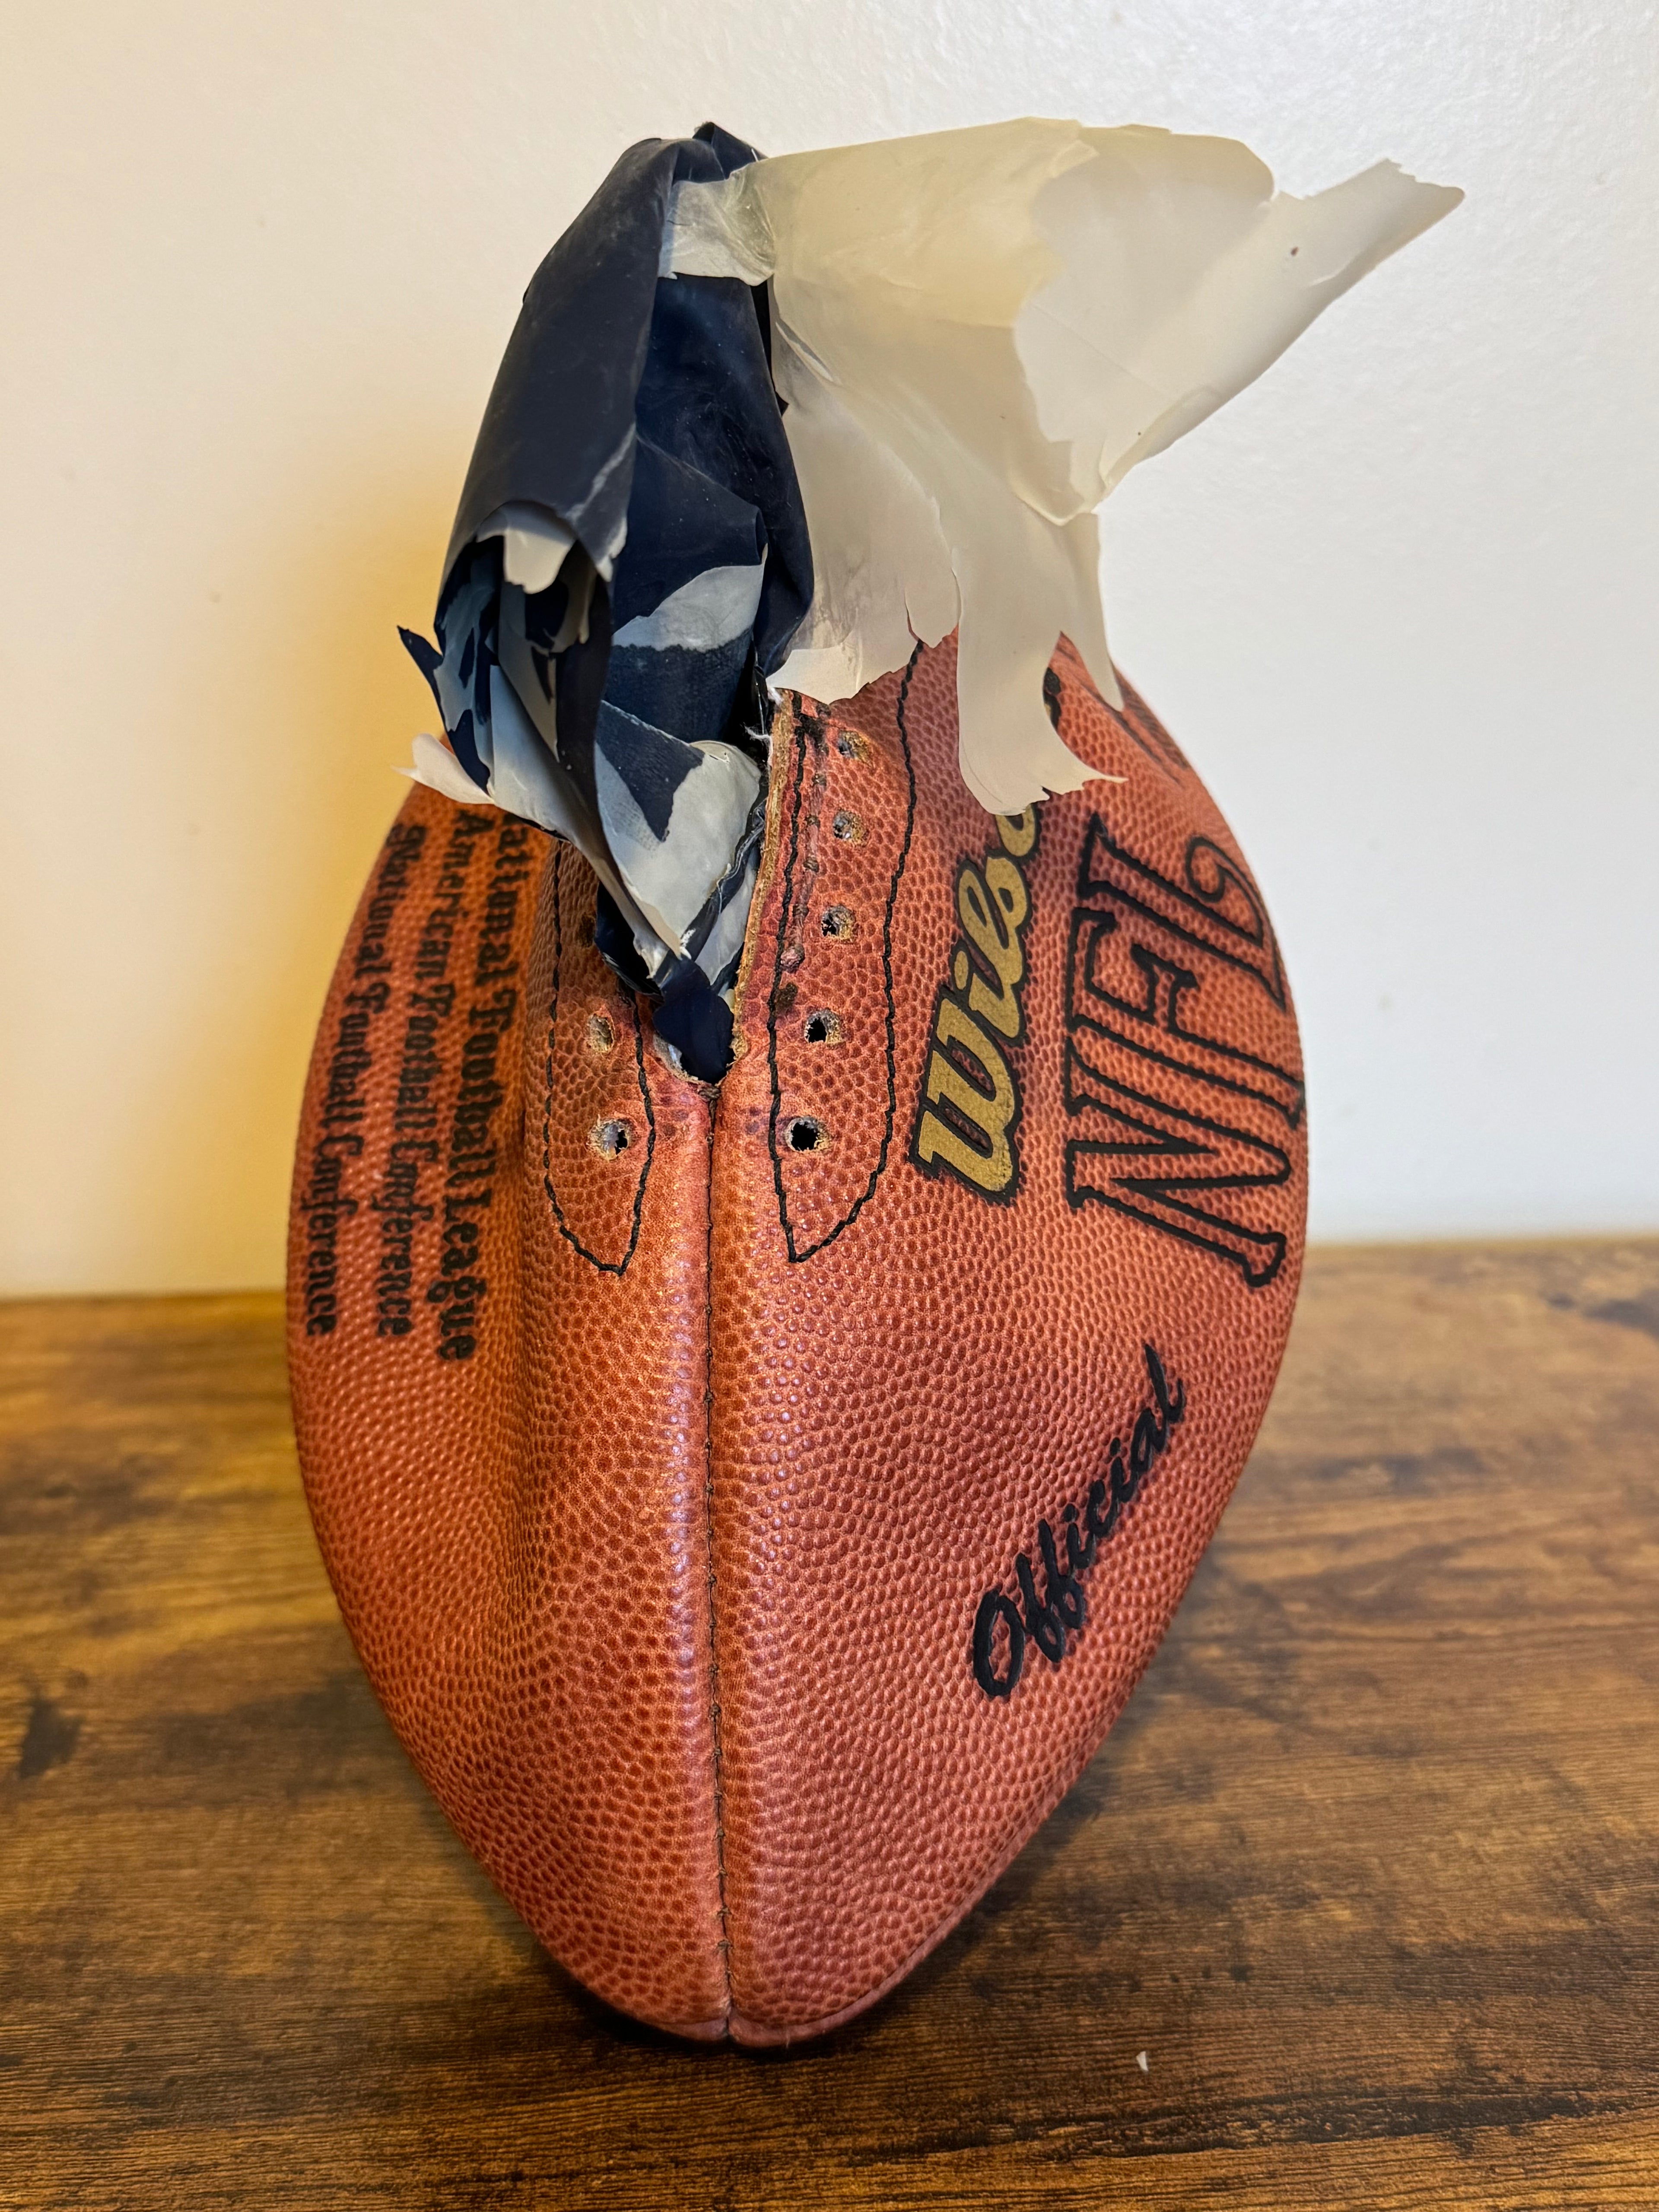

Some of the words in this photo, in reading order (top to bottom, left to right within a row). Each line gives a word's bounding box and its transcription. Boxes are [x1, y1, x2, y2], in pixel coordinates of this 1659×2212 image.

[353, 824, 426, 979] National
[414, 810, 496, 979] American
[476, 814, 531, 986] ational
[321, 983, 391, 1129] Football
[394, 983, 455, 1131] Football
[444, 989, 518, 1188] Football
[908, 798, 1042, 1205] Wilso
[1066, 810, 1306, 1288] NFL
[300, 1135, 364, 1337] Conference
[371, 1139, 439, 1337] Conference
[426, 1189, 492, 1361] League
[972, 1340, 1187, 1697] Official
